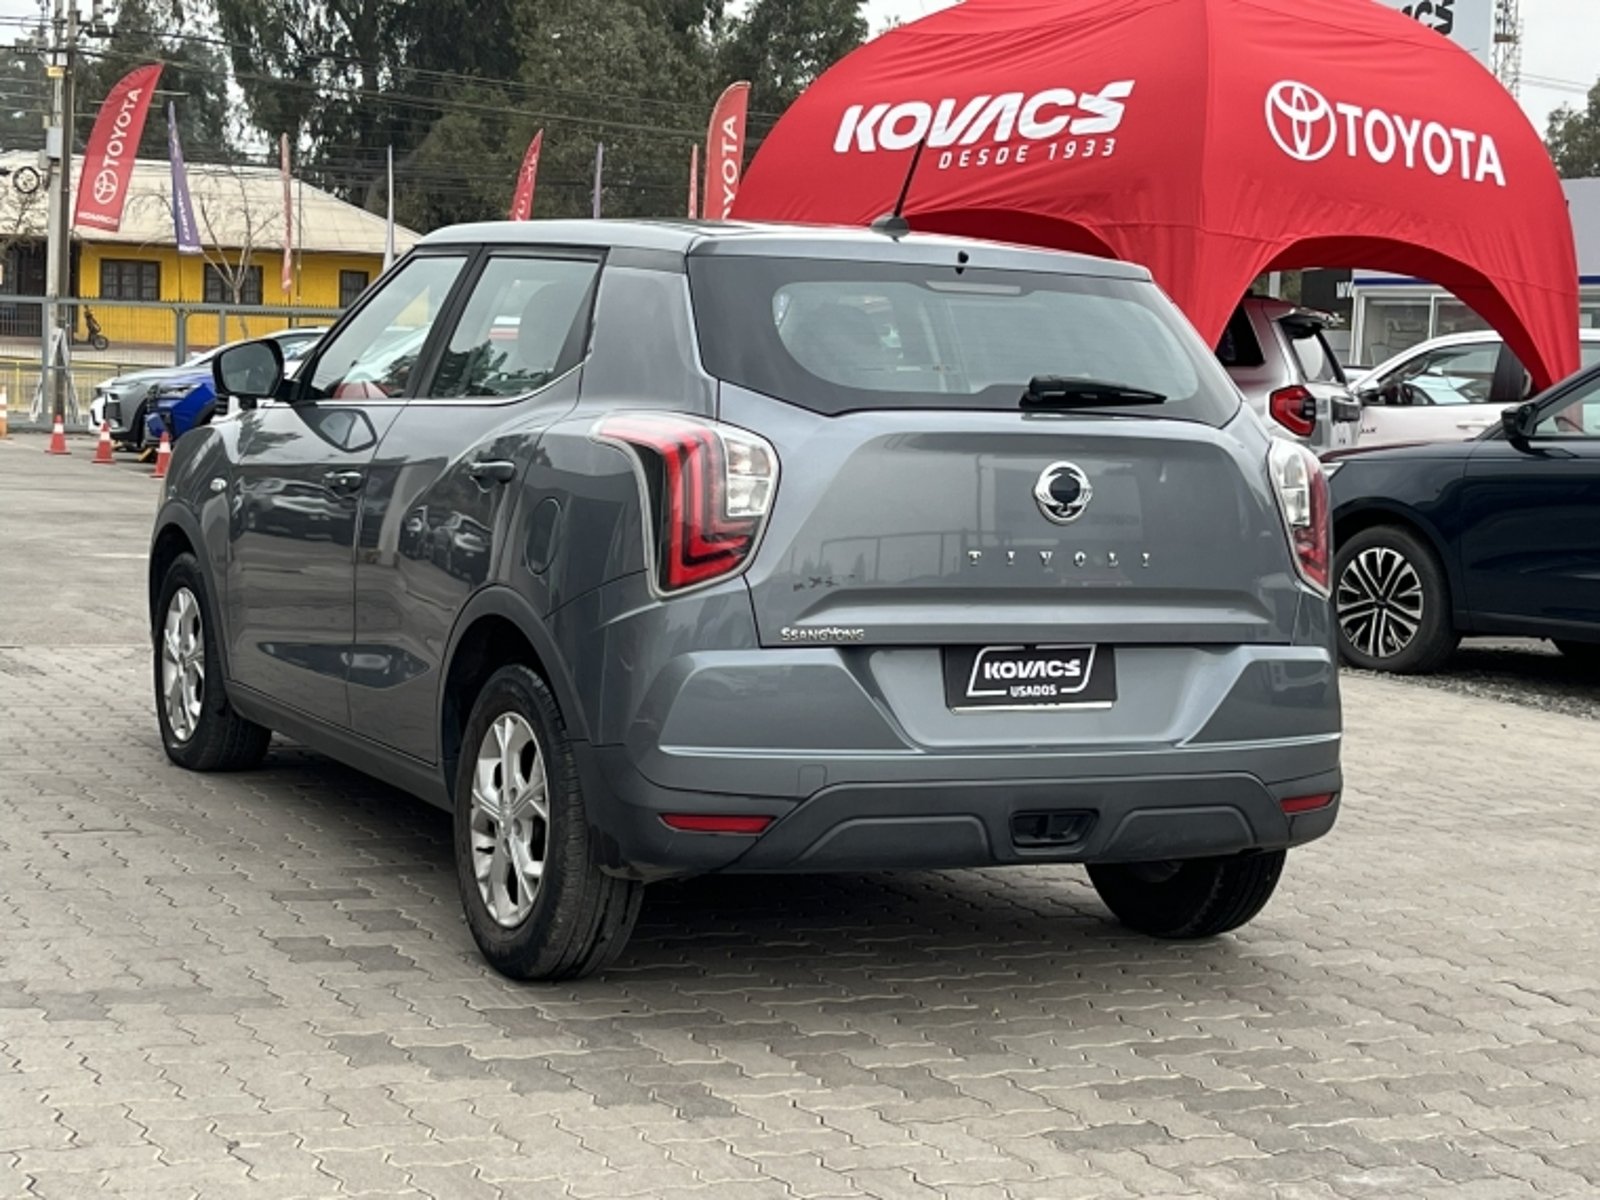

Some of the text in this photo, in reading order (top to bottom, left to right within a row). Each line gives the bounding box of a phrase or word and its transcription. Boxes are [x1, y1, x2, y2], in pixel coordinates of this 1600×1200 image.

[102, 88, 142, 167] TOYOTA
[833, 80, 1135, 152] KOVACS
[938, 138, 1115, 169] DESDE 1933
[1336, 102, 1506, 186] TOYOTA
[968, 550, 1150, 568] TIVOLI
[984, 659, 1081, 679] KOVACS
[1010, 684, 1057, 697] USADOS
